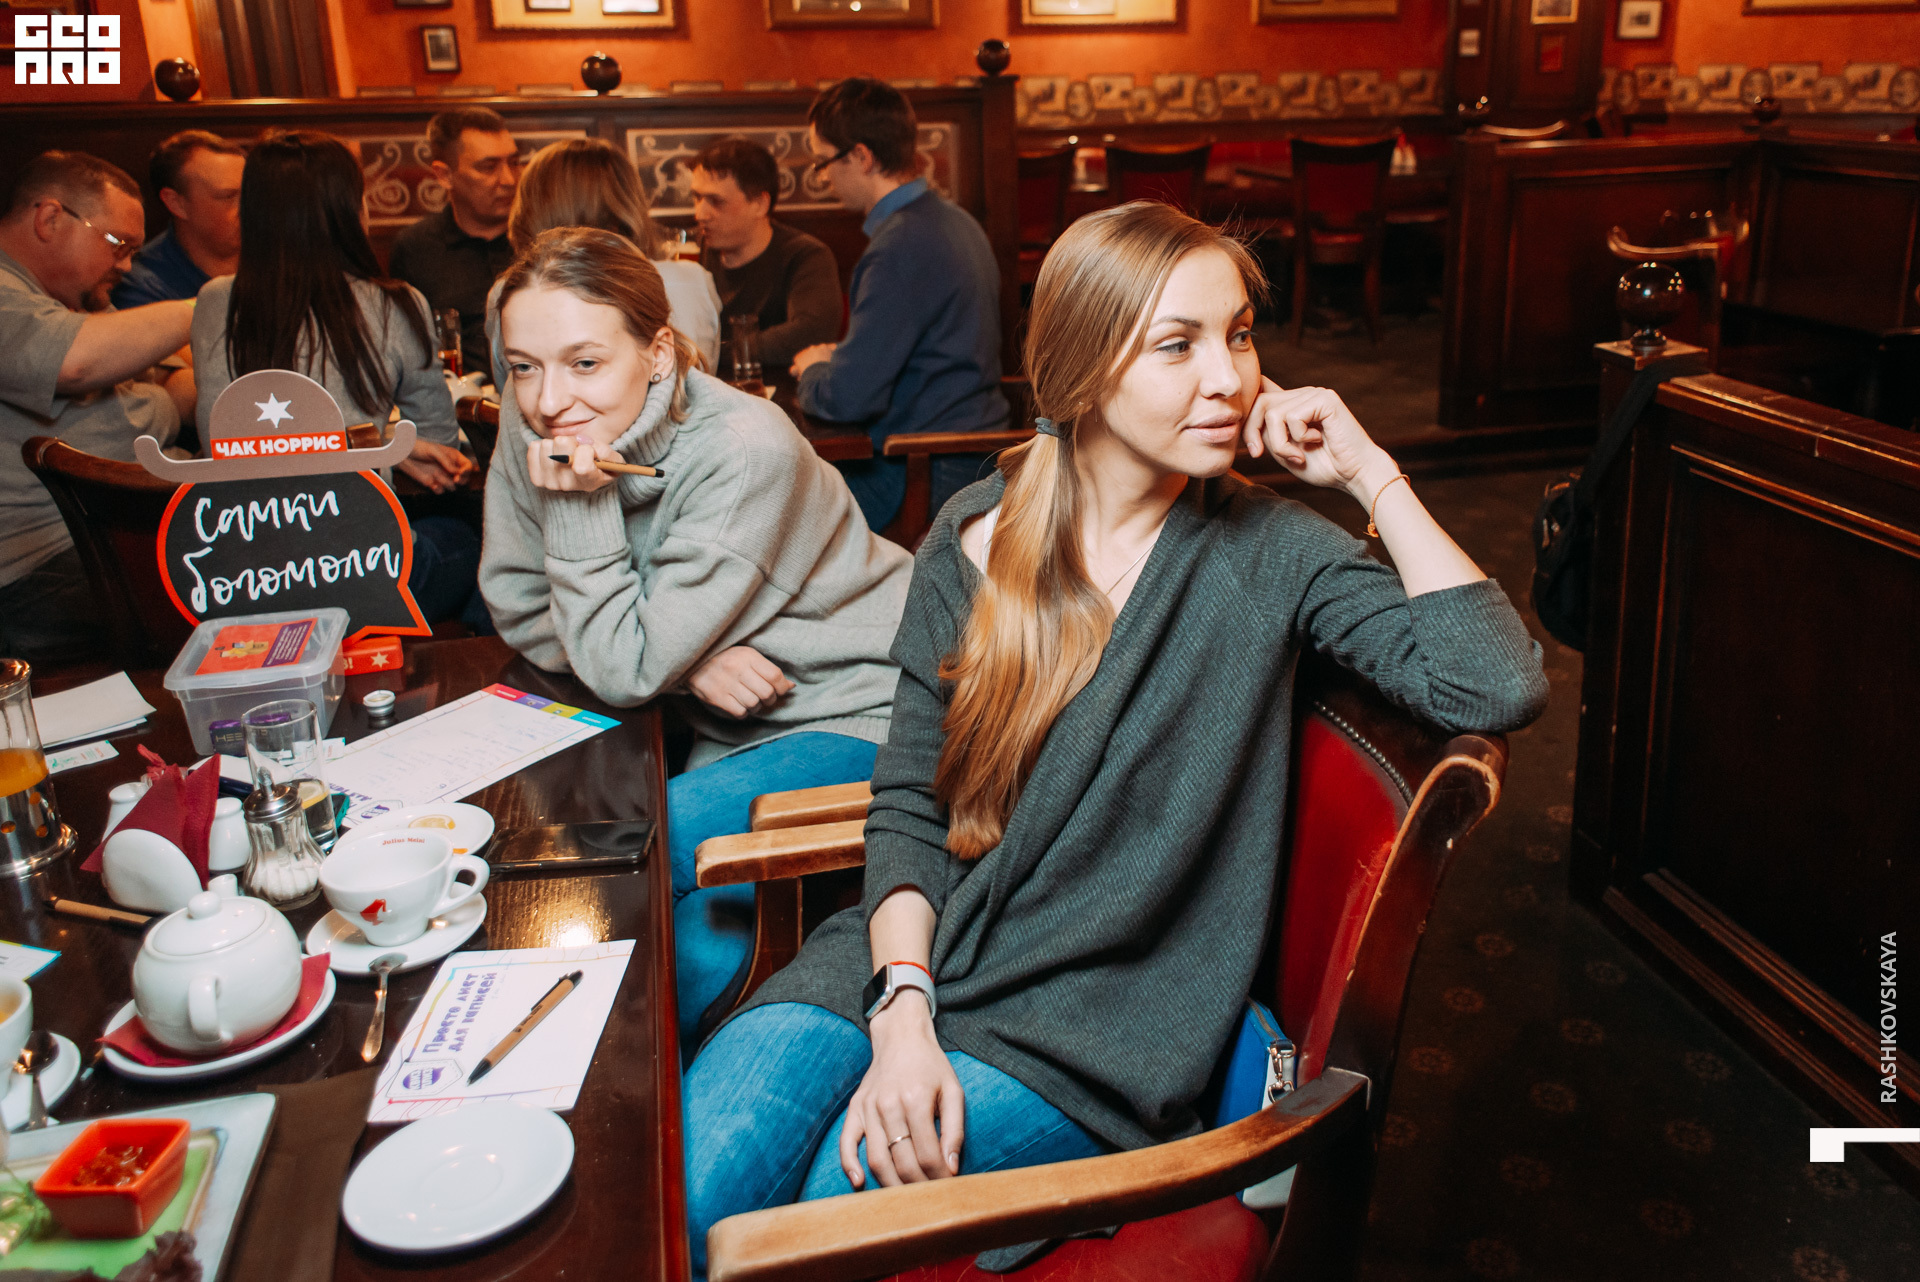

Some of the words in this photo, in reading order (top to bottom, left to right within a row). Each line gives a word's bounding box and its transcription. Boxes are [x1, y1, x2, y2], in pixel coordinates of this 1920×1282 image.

[215, 440, 257, 456] ЧАК
[260, 434, 341, 454] НОРРИС
[194, 490, 340, 543] Самки
[182, 543, 400, 614] богомола
[422, 1006, 462, 1053] Просто
[457, 973, 479, 1001] лист
